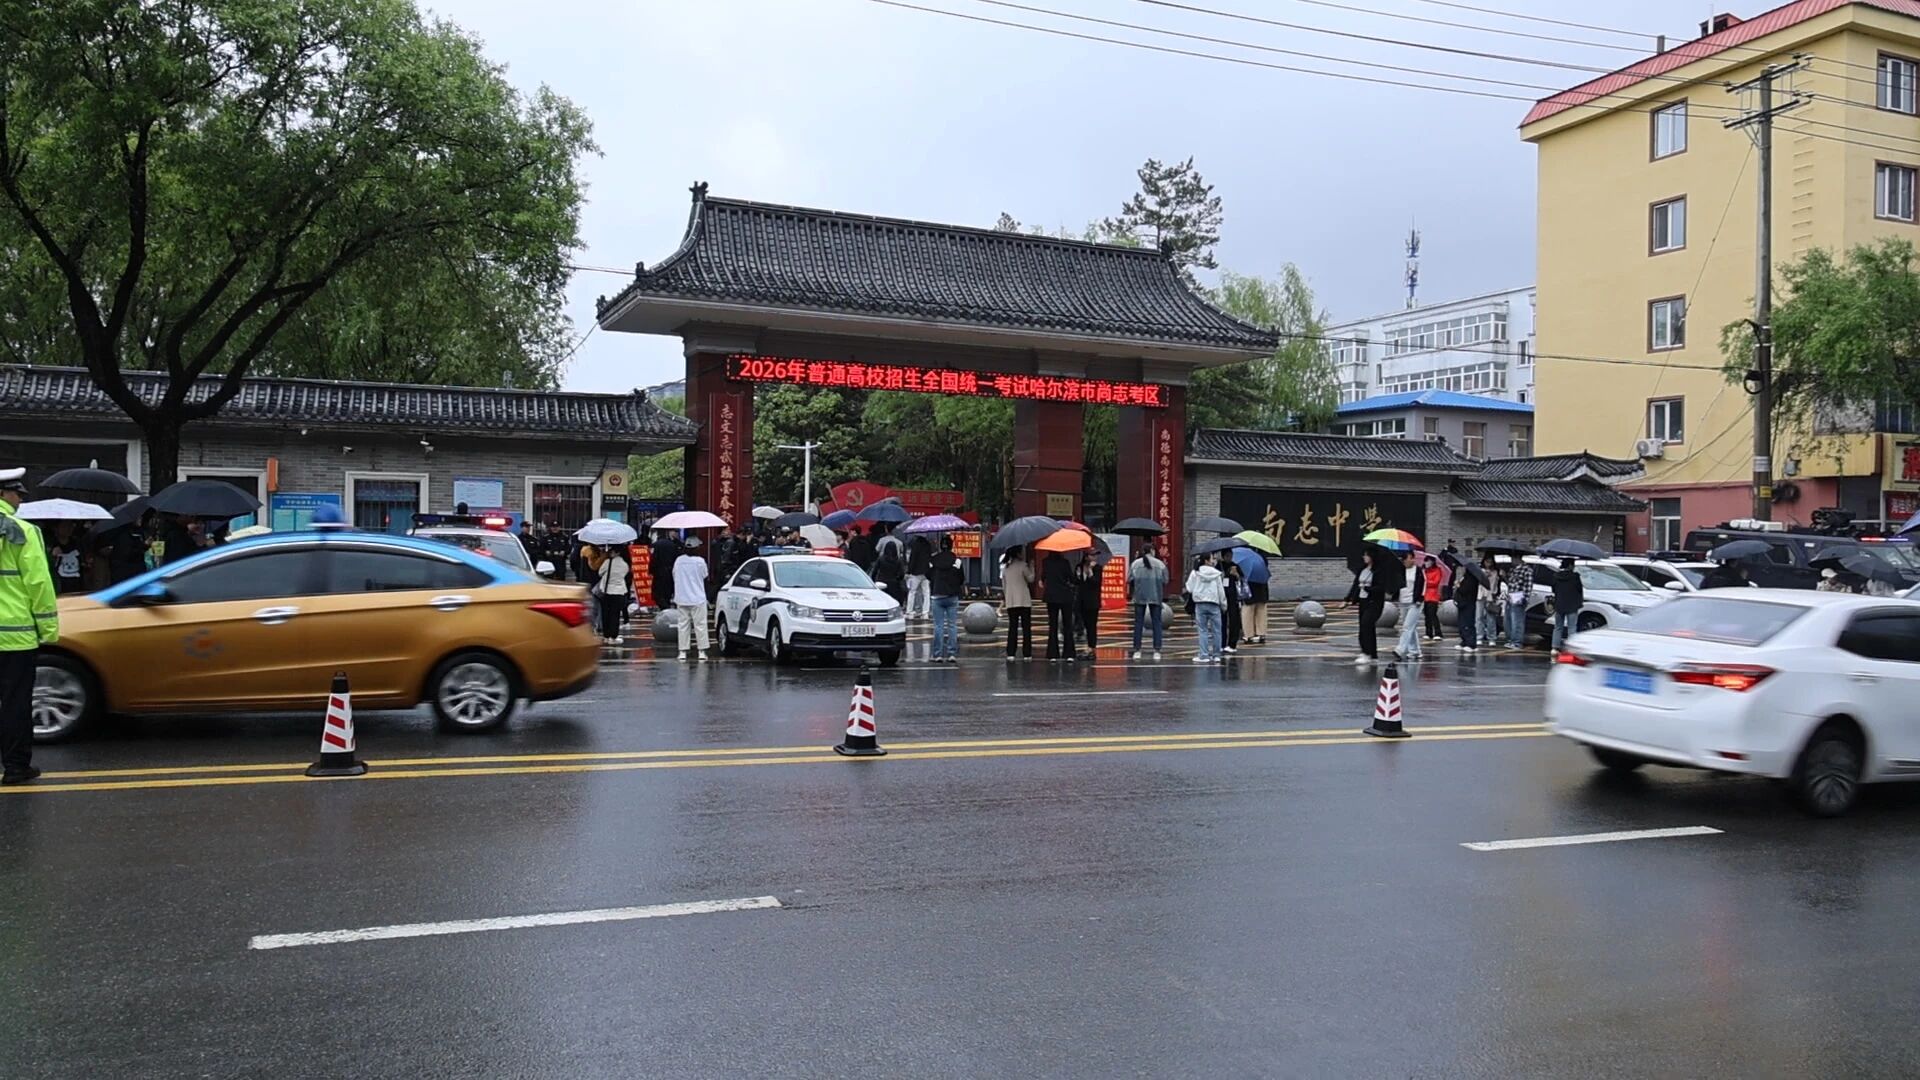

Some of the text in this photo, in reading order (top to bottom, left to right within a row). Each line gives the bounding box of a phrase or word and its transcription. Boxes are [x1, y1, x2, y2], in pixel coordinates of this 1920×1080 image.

[739, 359, 1160, 404] 2026年普通高校招生全国统一考试哈尔滨市尚志考区
